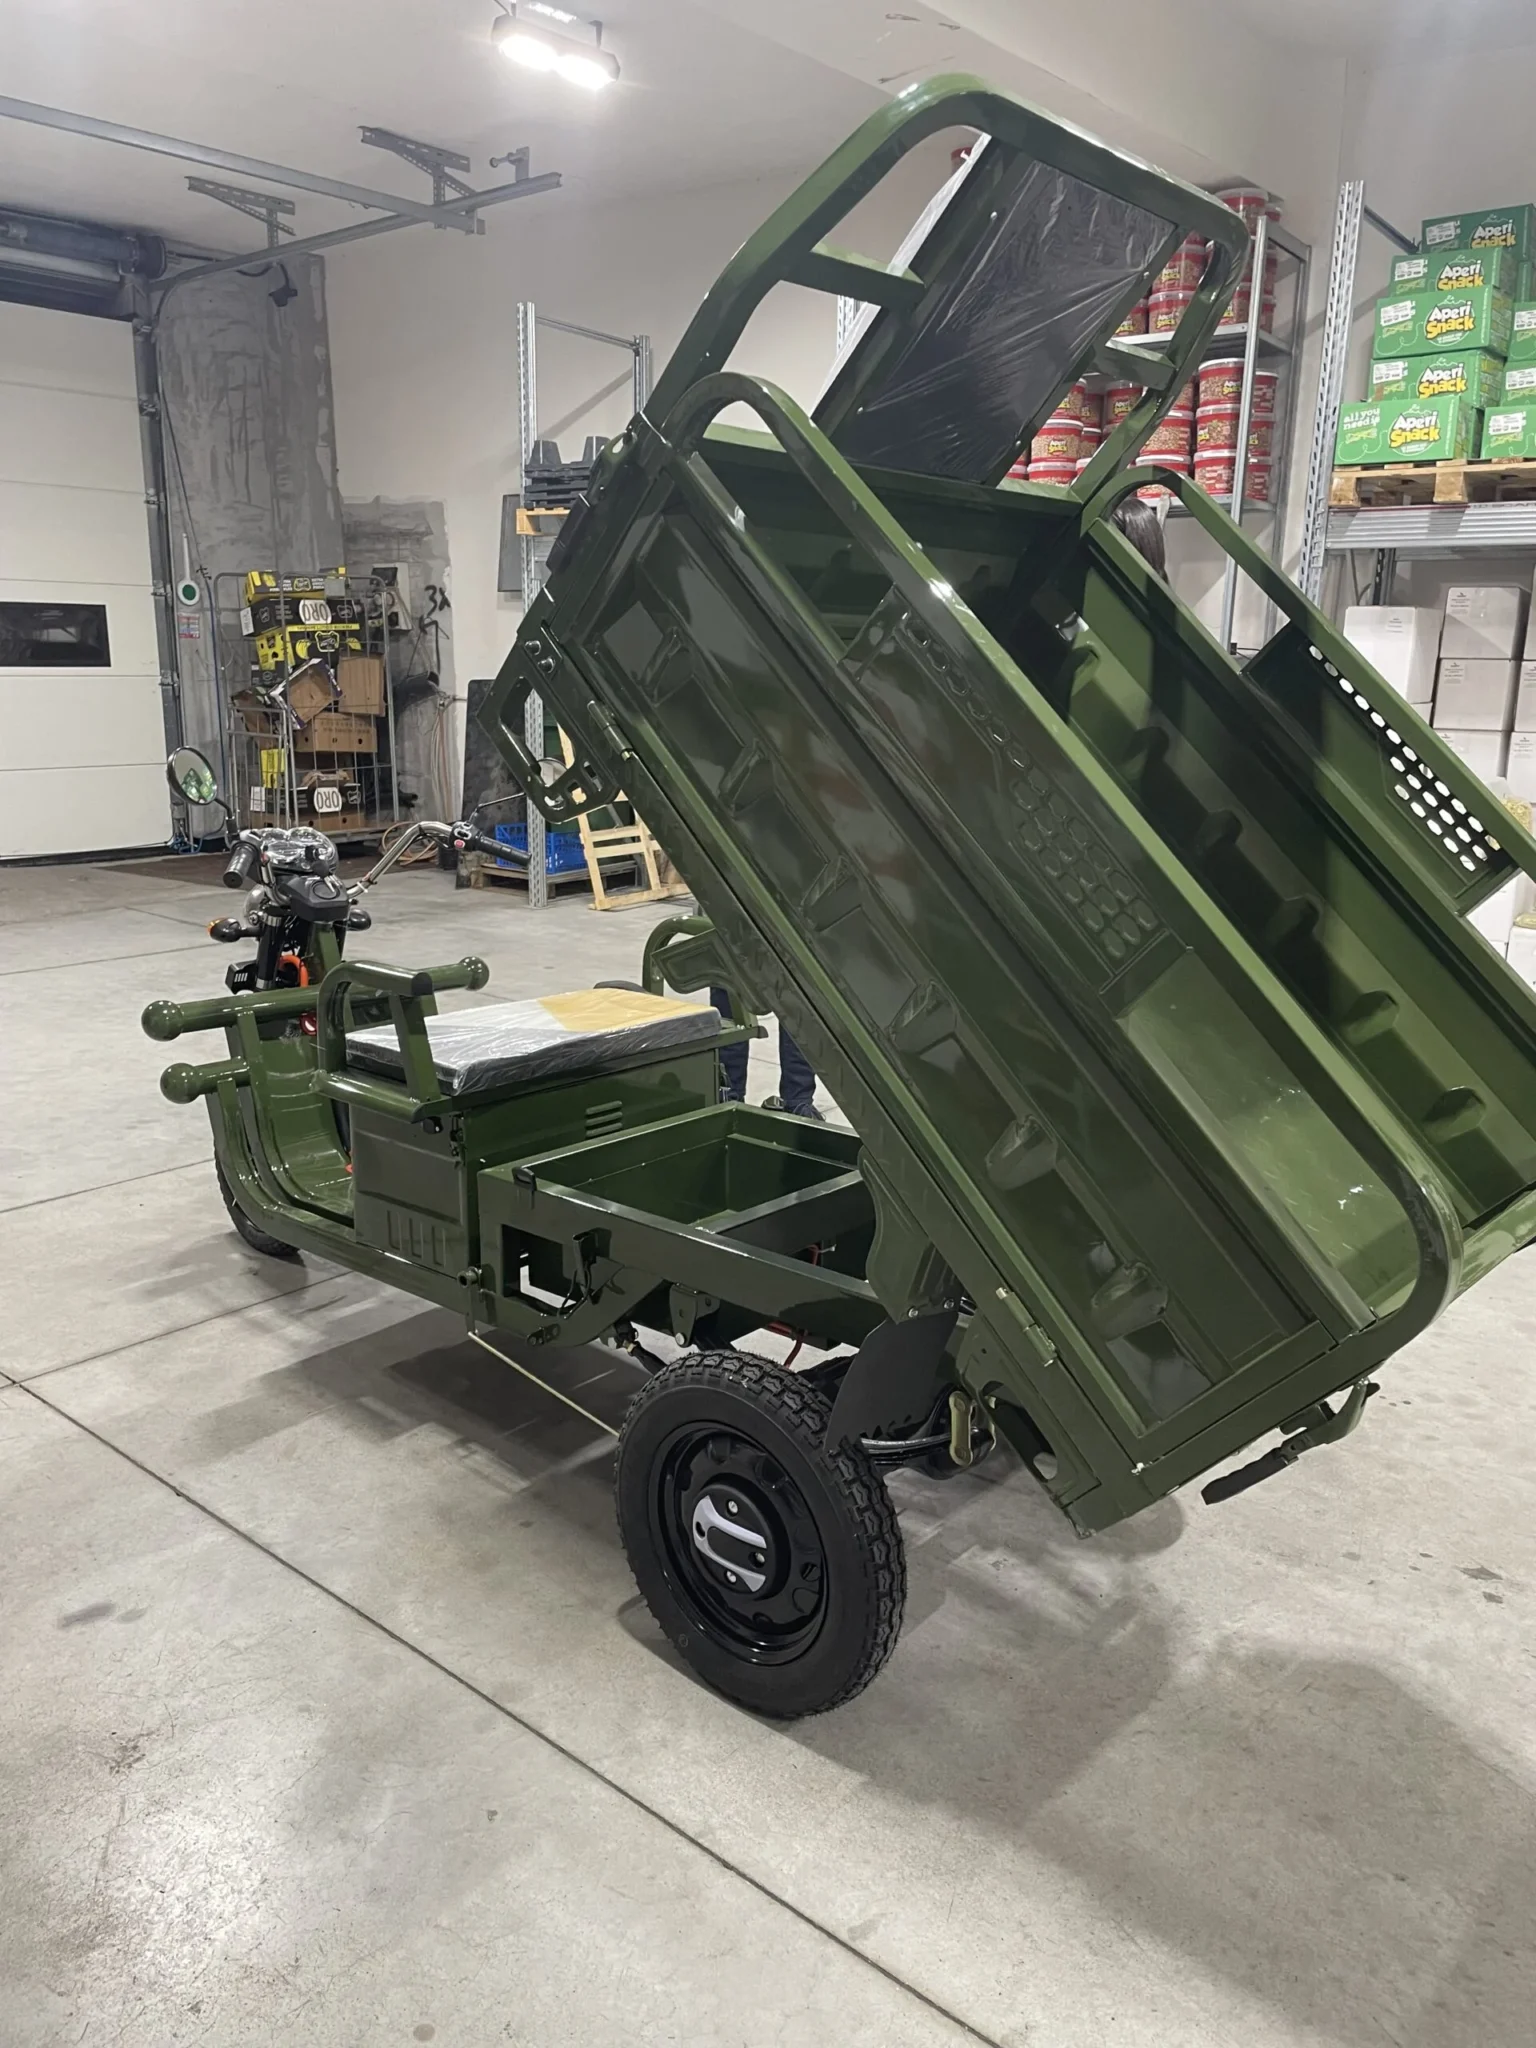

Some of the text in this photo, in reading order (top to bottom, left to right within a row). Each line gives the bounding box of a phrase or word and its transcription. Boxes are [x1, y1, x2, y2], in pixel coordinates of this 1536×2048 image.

[1473, 219, 1513, 240] Aperi
[1471, 234, 1516, 249] Snack
[1440, 260, 1482, 280] Aperi
[1437, 274, 1484, 291] Snack
[1428, 300, 1472, 322] Aperi
[1426, 316, 1475, 339] Snack
[1421, 363, 1464, 383] Aperi
[1418, 377, 1467, 399] Snack
[1343, 408, 1380, 423] all you
[1343, 417, 1370, 430] need
[1392, 411, 1438, 431] Aperi
[1390, 426, 1441, 448] Snack
[302, 603, 329, 621] ORO
[316, 791, 340, 810] ORO
